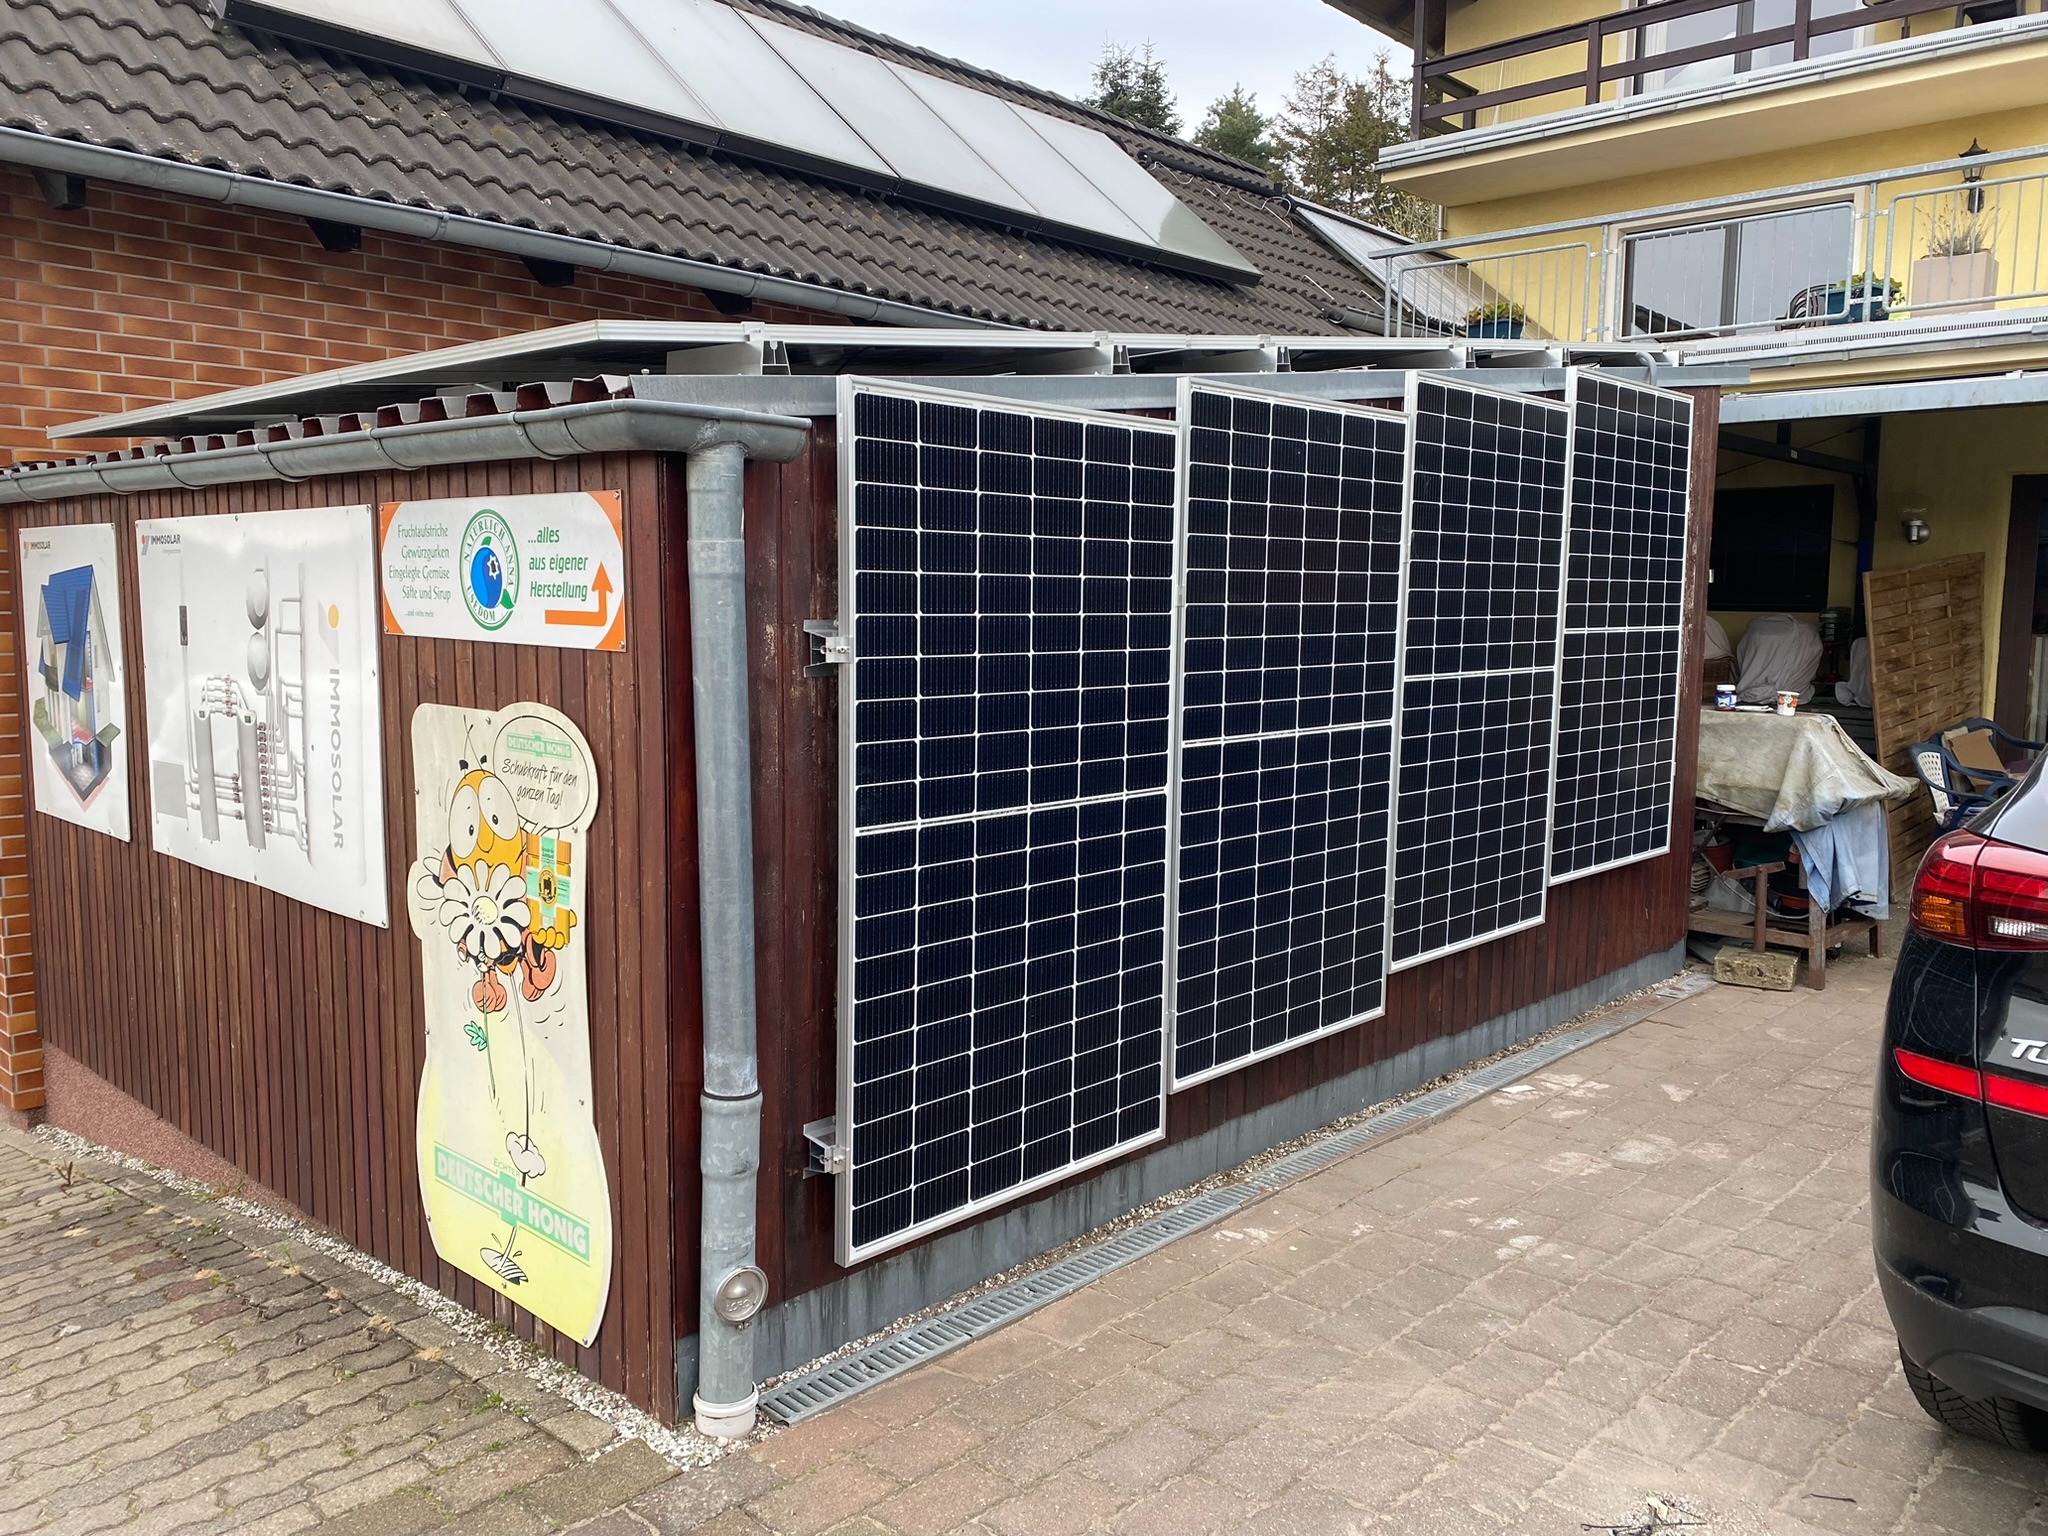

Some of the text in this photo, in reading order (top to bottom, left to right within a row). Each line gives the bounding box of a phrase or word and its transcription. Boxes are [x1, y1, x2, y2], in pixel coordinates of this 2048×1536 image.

[150, 534, 181, 546] IMMOSOLAR
[398, 523, 448, 538] Fruchtaufstriche
[528, 527, 560, 543] ...alles
[401, 545, 449, 562] Gewürzgurken
[389, 565, 450, 582] Eingelegte Gemüse
[504, 545, 515, 586] ANNA
[529, 554, 588, 574] aus eigener
[402, 585, 451, 602] Säfte und Sirup
[530, 581, 588, 602] Herstellung
[467, 585, 495, 621] USEDOM
[508, 737, 571, 757] DEUTSCHER HONIG
[329, 668, 343, 849] IMMOSOLAR
[502, 758, 577, 787] Schubkraft für den
[516, 785, 564, 810] ganzen Tag!
[437, 1150, 586, 1254] DEUTSCHER HONIG
